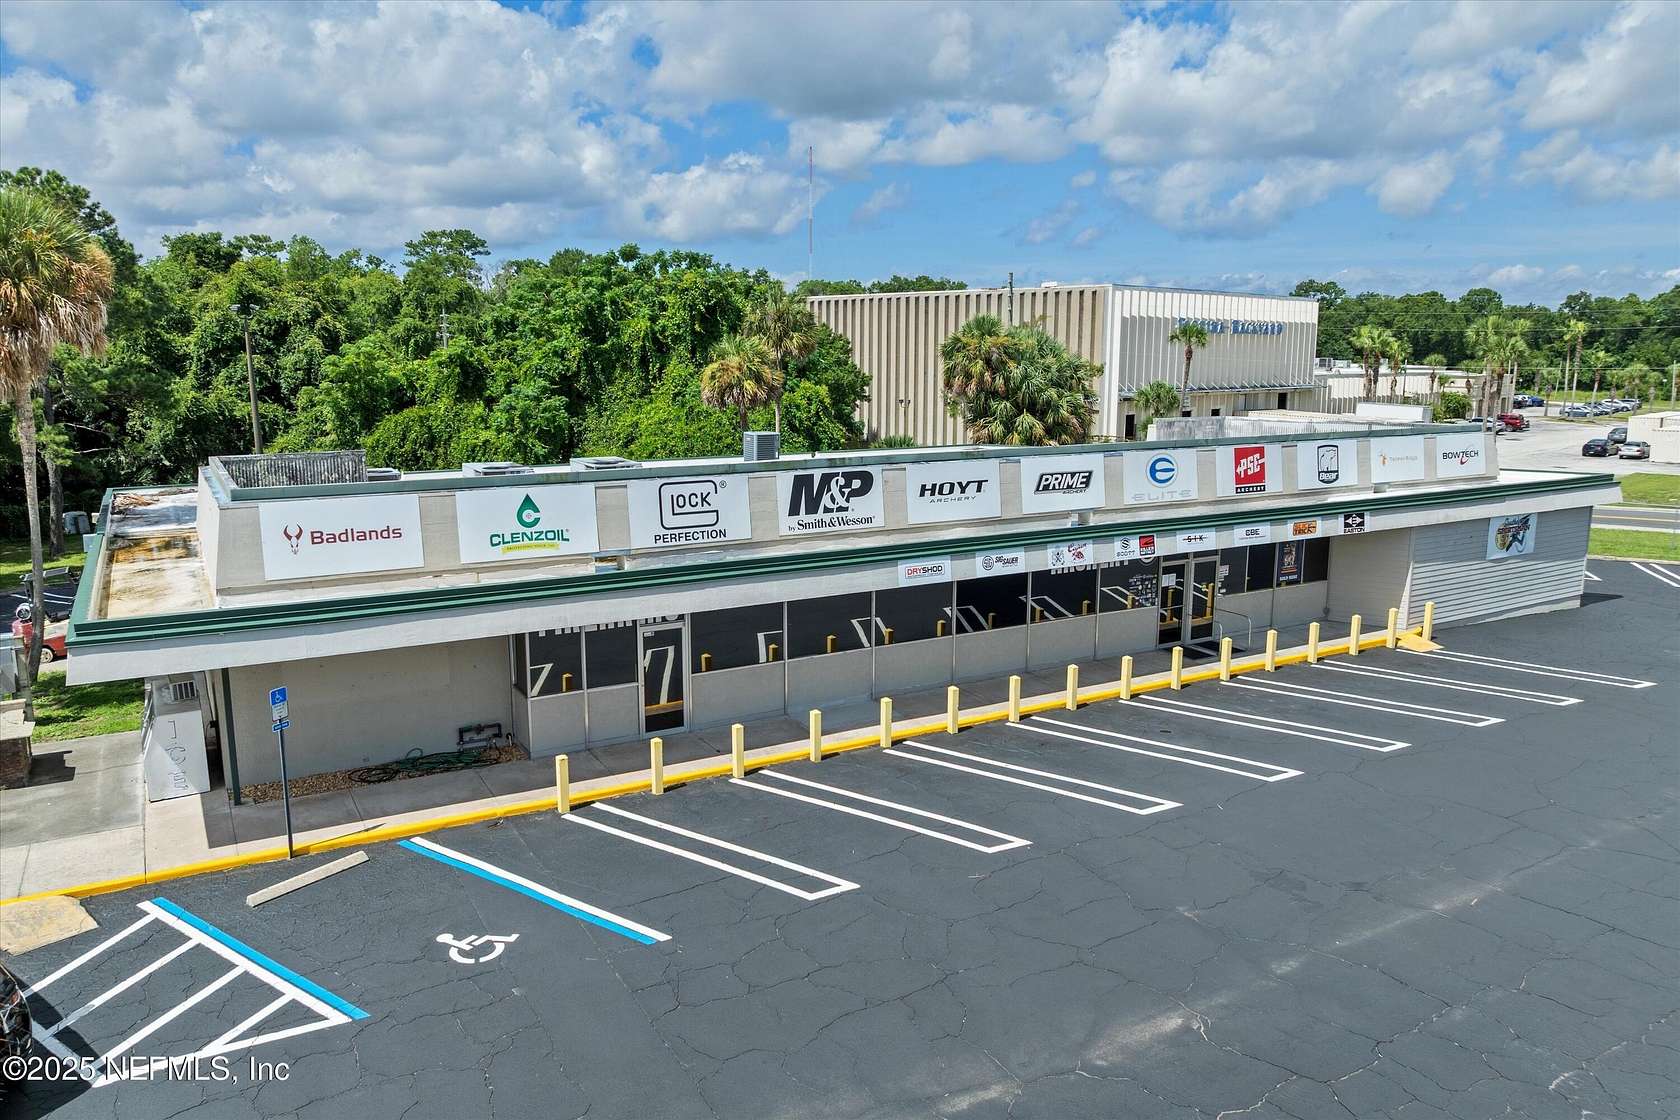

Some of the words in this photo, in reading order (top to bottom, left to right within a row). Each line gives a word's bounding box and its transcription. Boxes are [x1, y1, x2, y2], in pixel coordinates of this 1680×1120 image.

[1442, 449, 1479, 460] BOWTECH
[1238, 453, 1262, 478] PSE
[919, 479, 988, 497] HOYT
[1040, 472, 1090, 491] PRIME
[788, 470, 874, 516] M&P
[929, 495, 976, 503] ARCHERY
[310, 525, 403, 545] Badlands
[490, 529, 570, 547] CLENZOIL
[654, 528, 727, 544] PERFECTION
[907, 564, 943, 576] DRYSHOD
